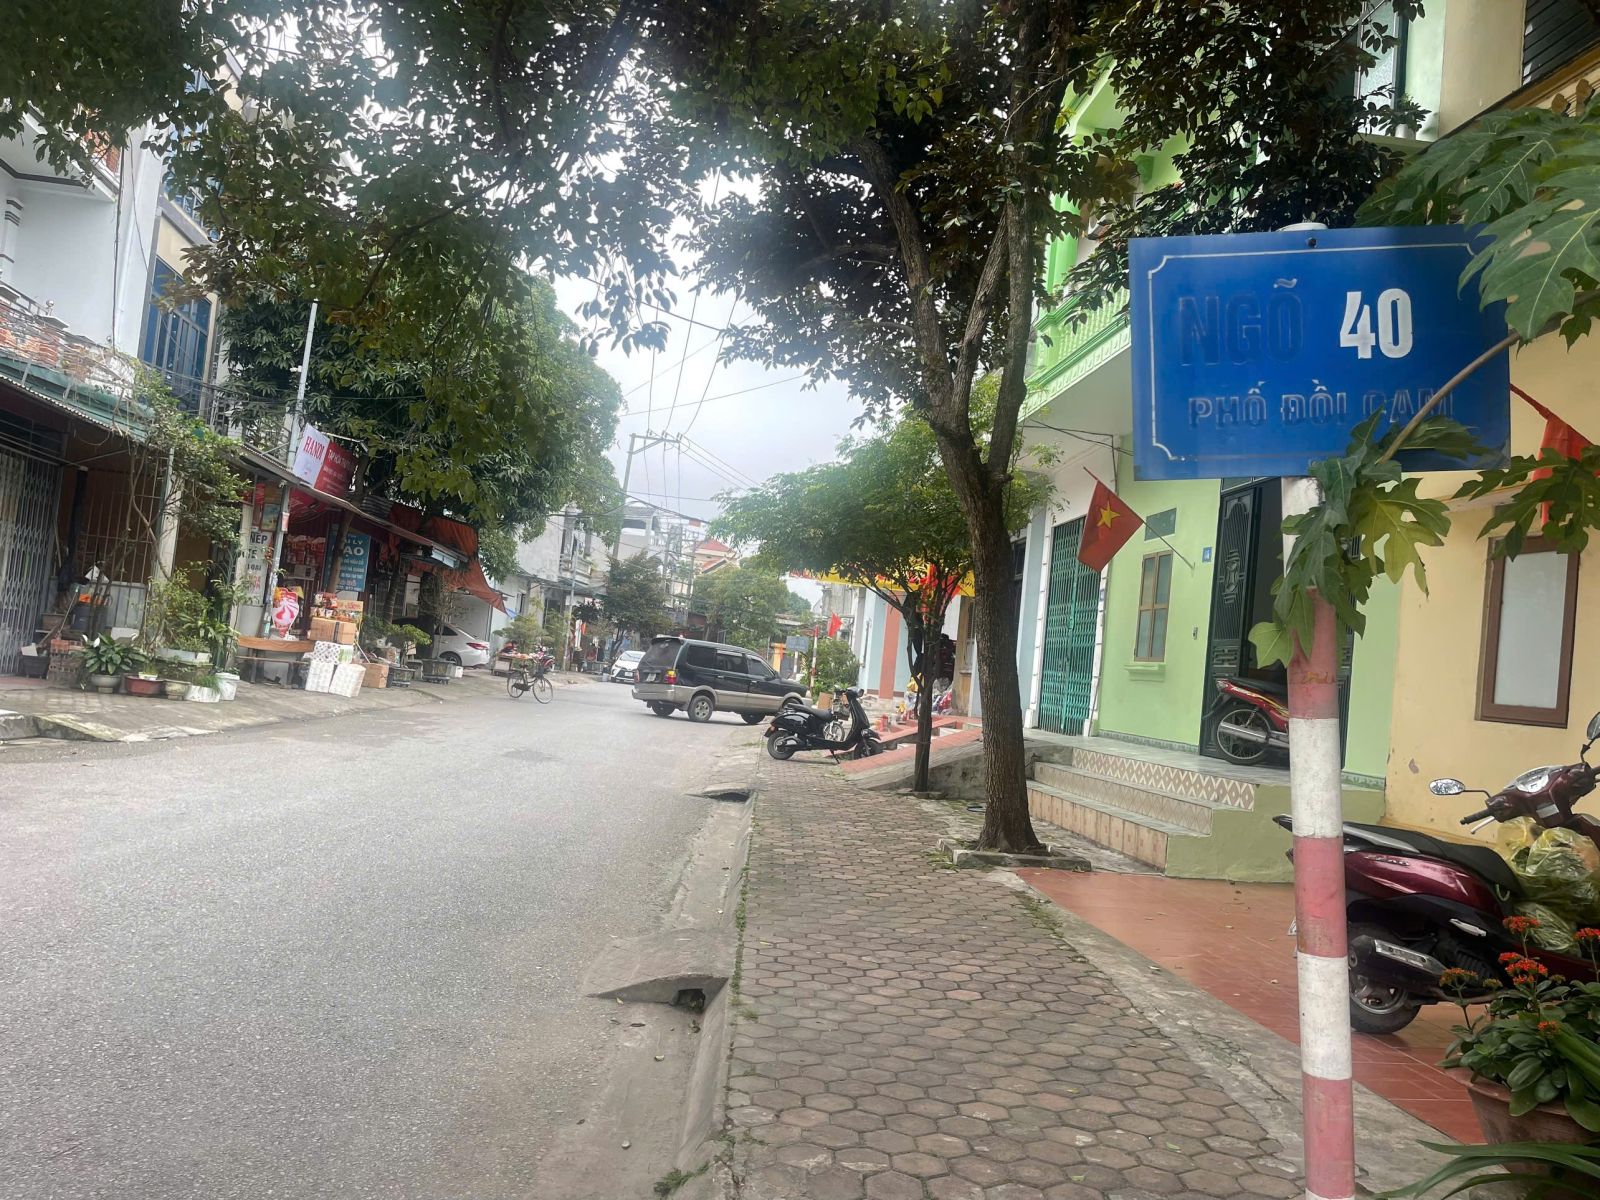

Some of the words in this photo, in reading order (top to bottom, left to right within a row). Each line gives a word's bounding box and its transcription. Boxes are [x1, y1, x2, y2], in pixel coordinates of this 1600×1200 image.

[1179, 278, 1304, 366] NGÕ
[1339, 288, 1413, 359] 40
[1188, 380, 1268, 430] PHỐ
[1280, 378, 1348, 427] ĐỒI
